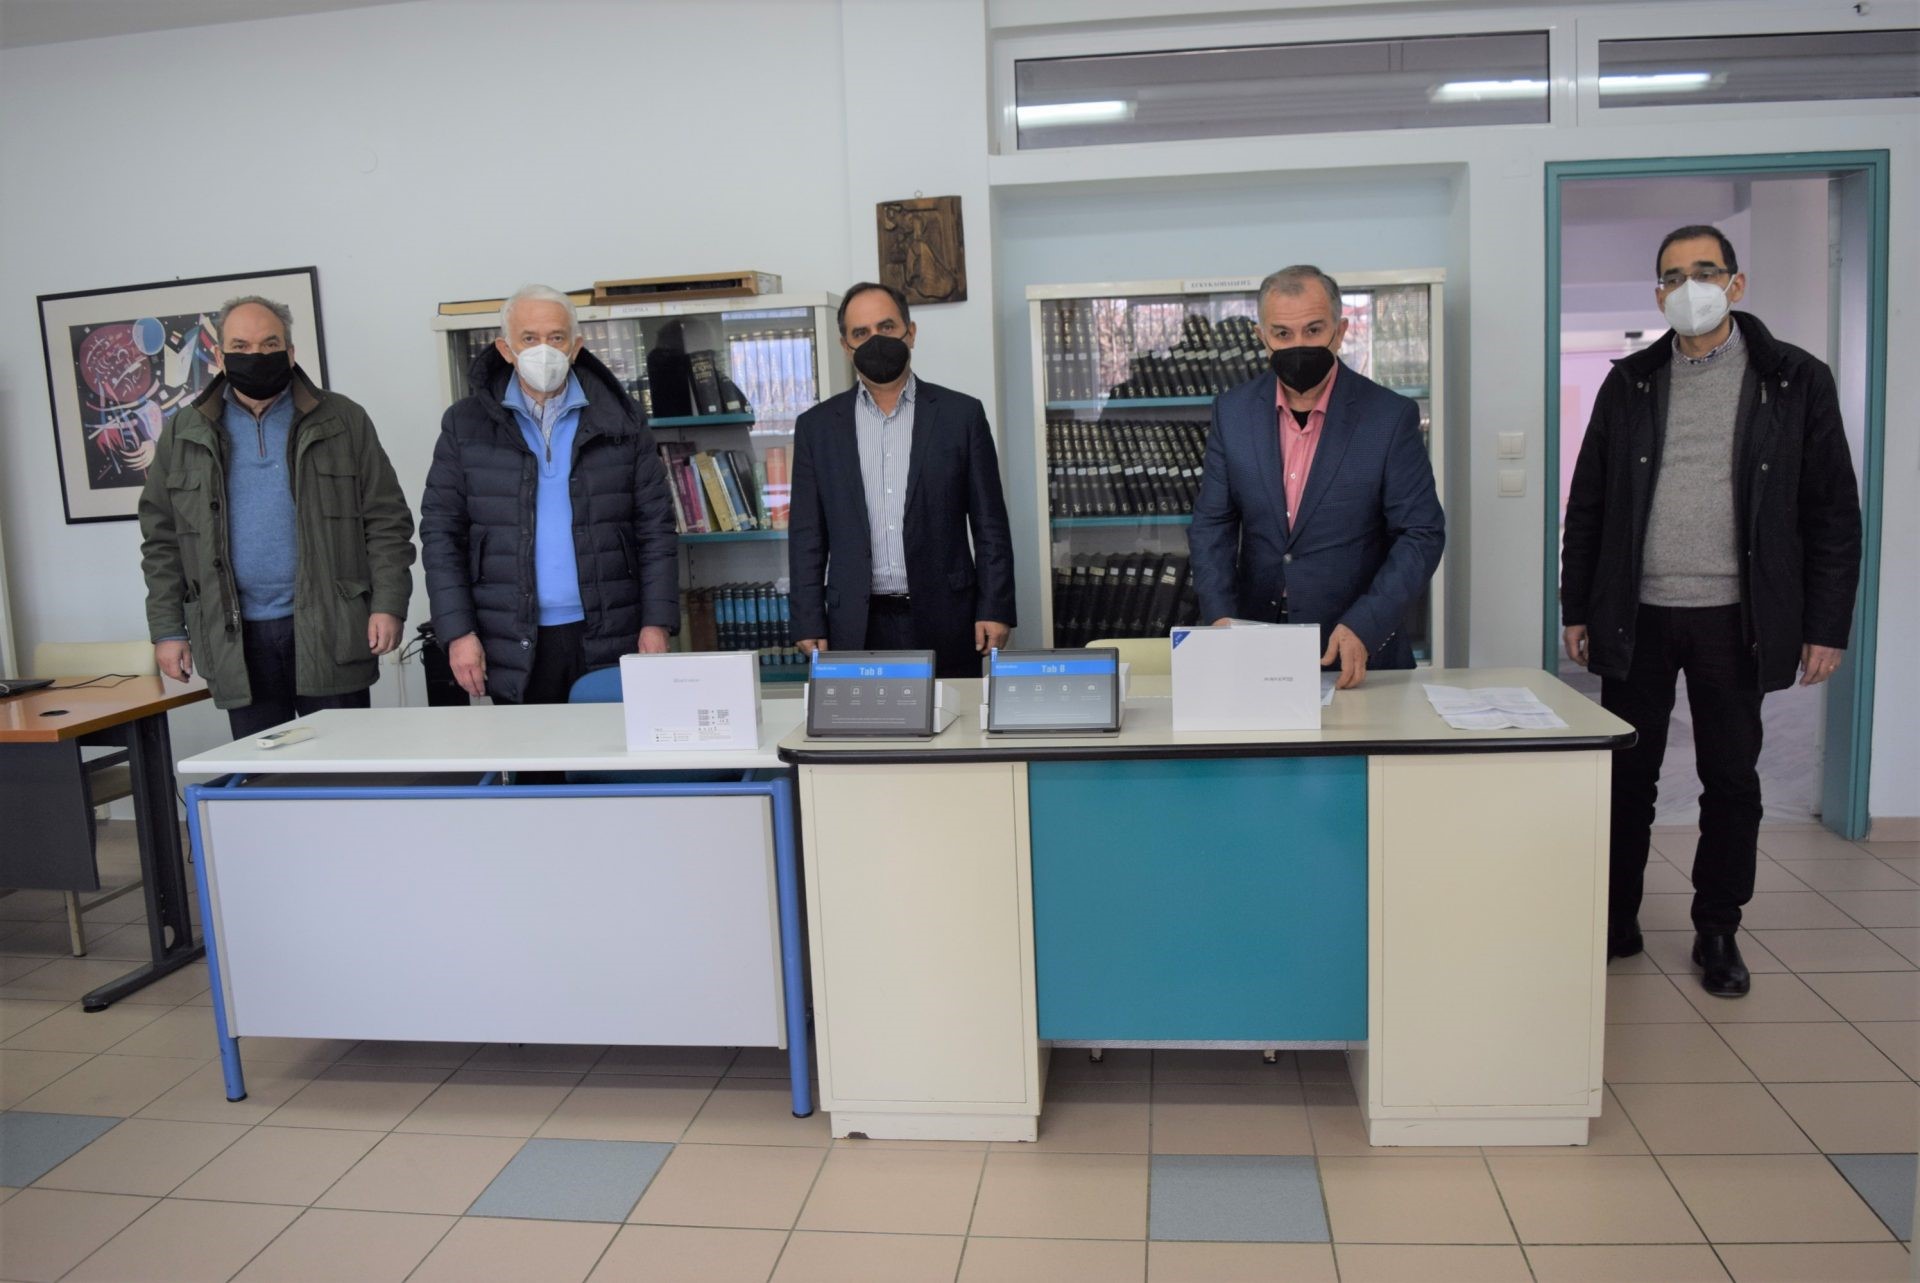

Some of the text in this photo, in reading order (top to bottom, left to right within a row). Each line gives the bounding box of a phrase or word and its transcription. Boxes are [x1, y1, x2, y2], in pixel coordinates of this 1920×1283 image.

[1114, 387, 1120, 397] 7
[860, 666, 884, 677] Tab 8
[1041, 664, 1066, 674] Tab 8
